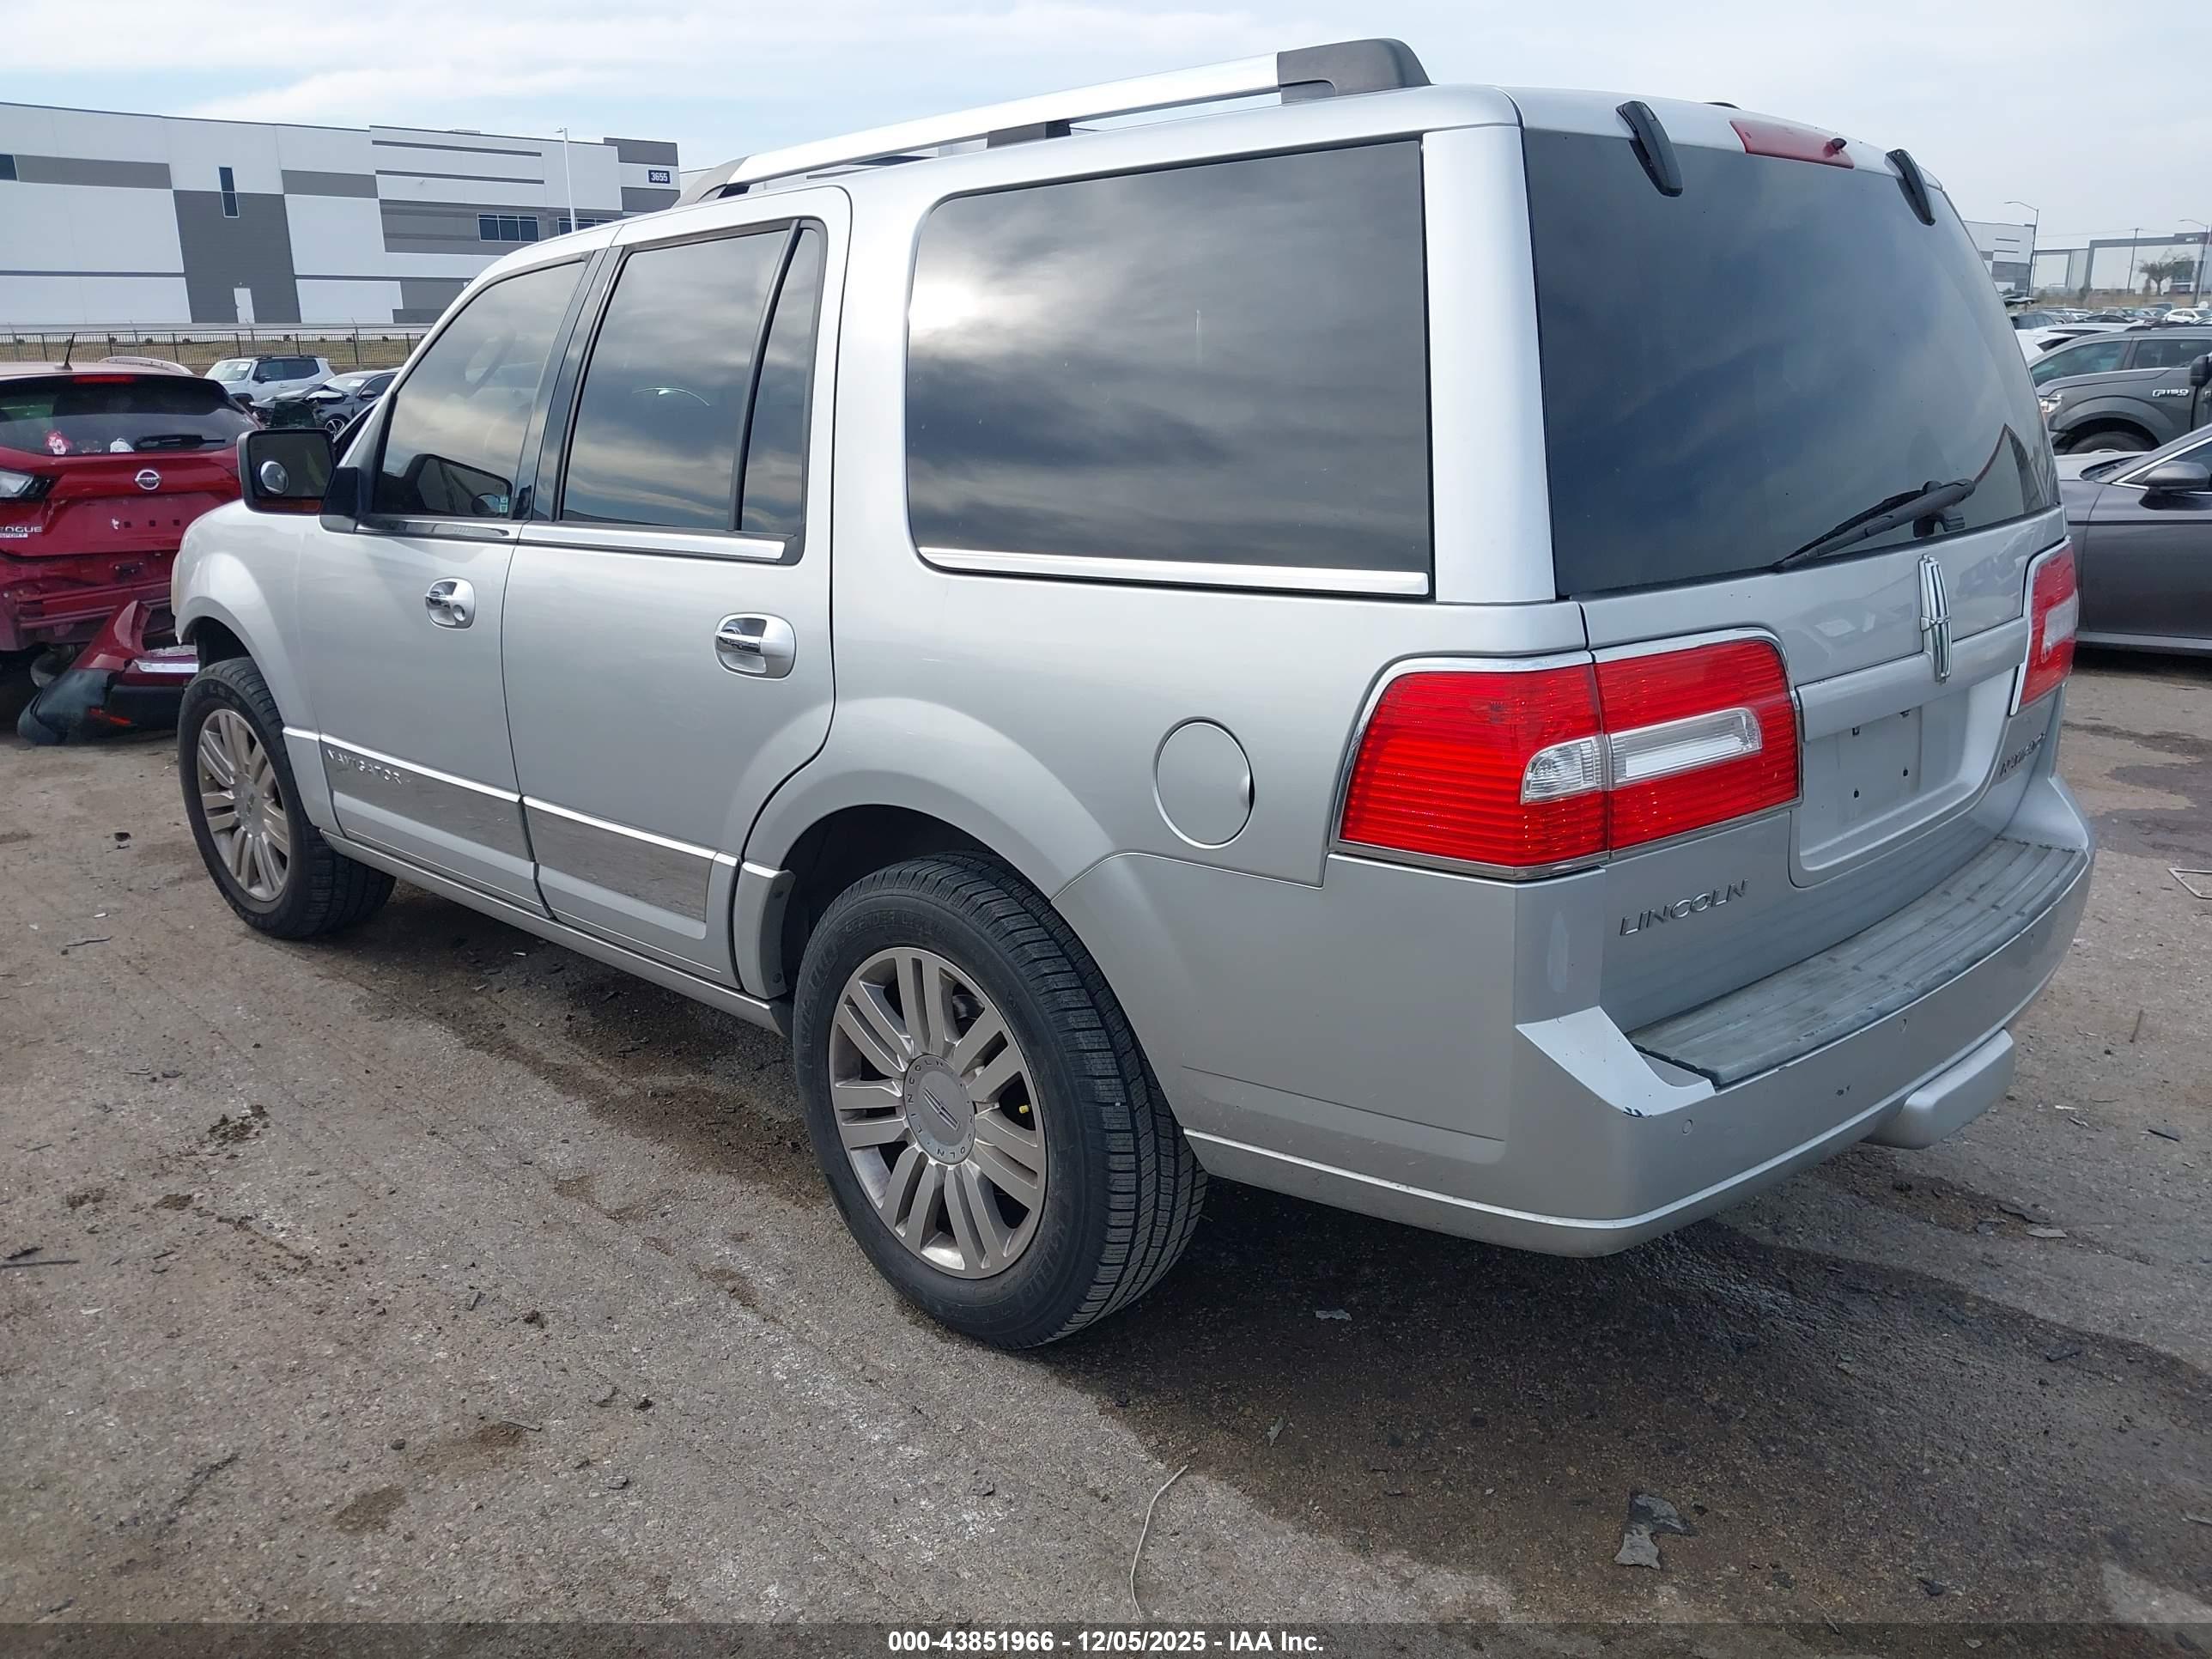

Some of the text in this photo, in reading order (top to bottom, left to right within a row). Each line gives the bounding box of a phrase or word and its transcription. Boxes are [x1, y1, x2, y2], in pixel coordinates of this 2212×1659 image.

[650, 172, 668, 182] 3655
[327, 749, 404, 785] NAVIGATOR
[1620, 878, 1749, 937] LINCOLN
